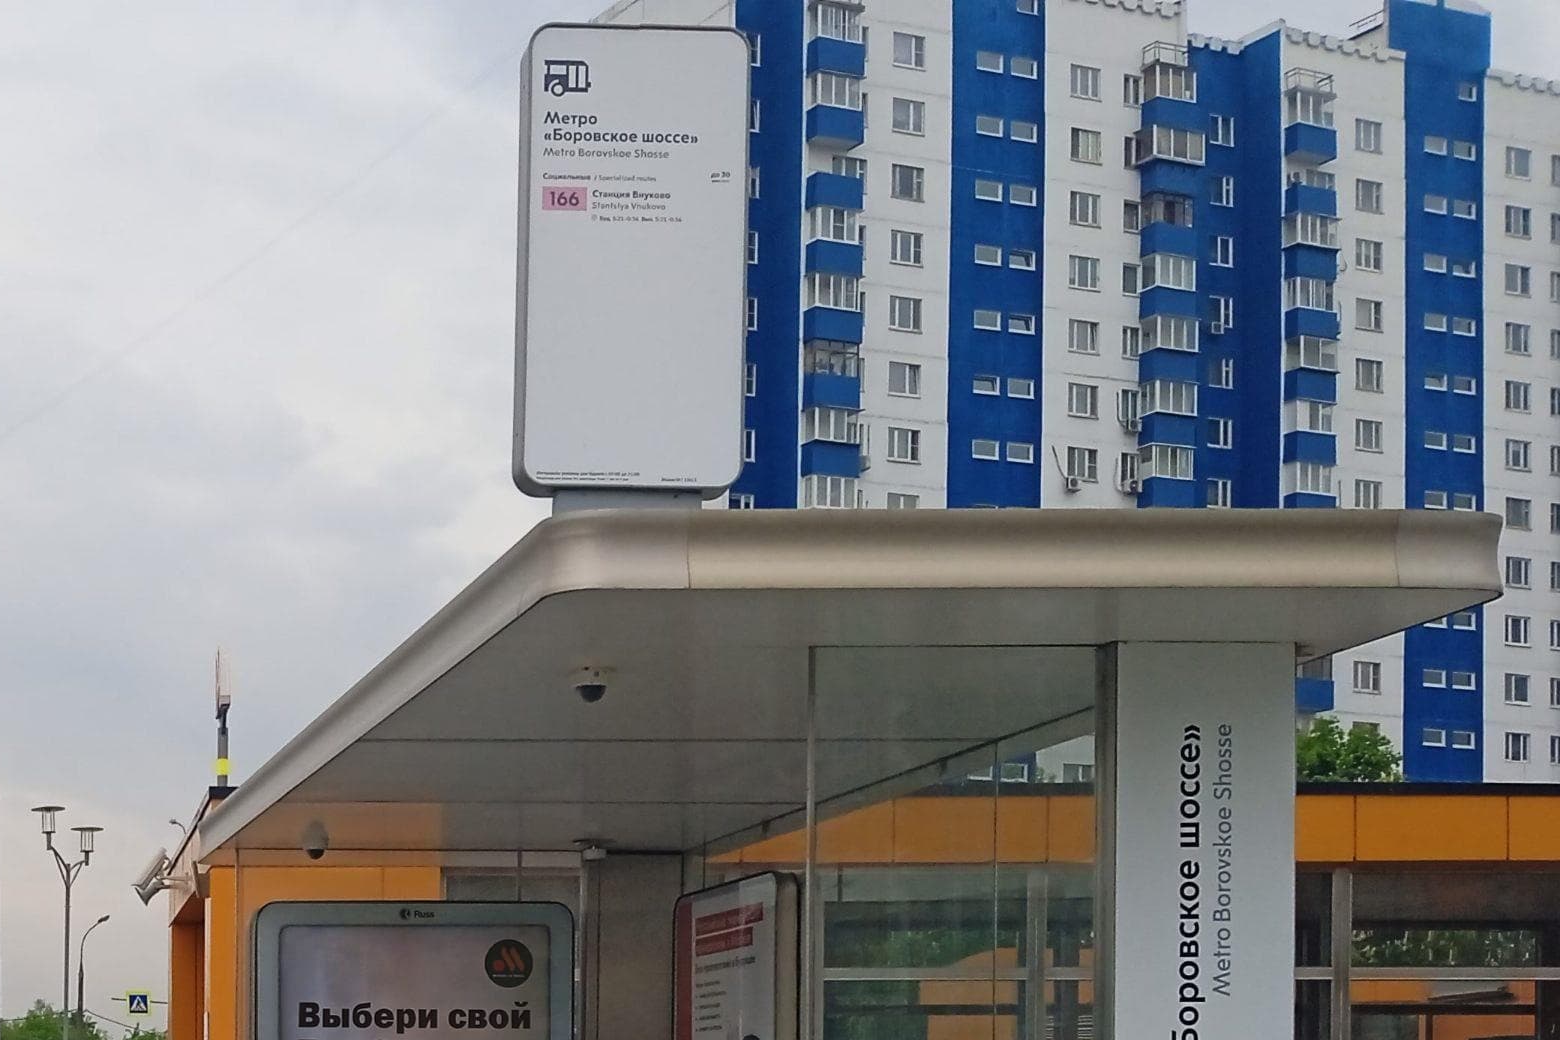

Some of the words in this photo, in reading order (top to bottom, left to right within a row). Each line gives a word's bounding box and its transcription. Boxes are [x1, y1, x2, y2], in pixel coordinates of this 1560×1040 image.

[543, 111, 597, 127] Метро
[544, 128, 637, 144] «Боровское
[642, 133, 698, 144] шоссе»
[543, 148, 575, 157] Metro
[578, 148, 631, 158] Borovskoe
[634, 149, 670, 159] Shosse
[550, 191, 580, 207] 166
[592, 189, 630, 199] Станция
[632, 190, 671, 200] Внуково
[1212, 723, 1232, 800] Shosse
[1180, 724, 1201, 848] шоссе»
[1212, 807, 1231, 921] Borovskoe
[1212, 928, 1231, 996] Metro
[298, 1002, 438, 1034] Выбери
[448, 1001, 531, 1029] свой
